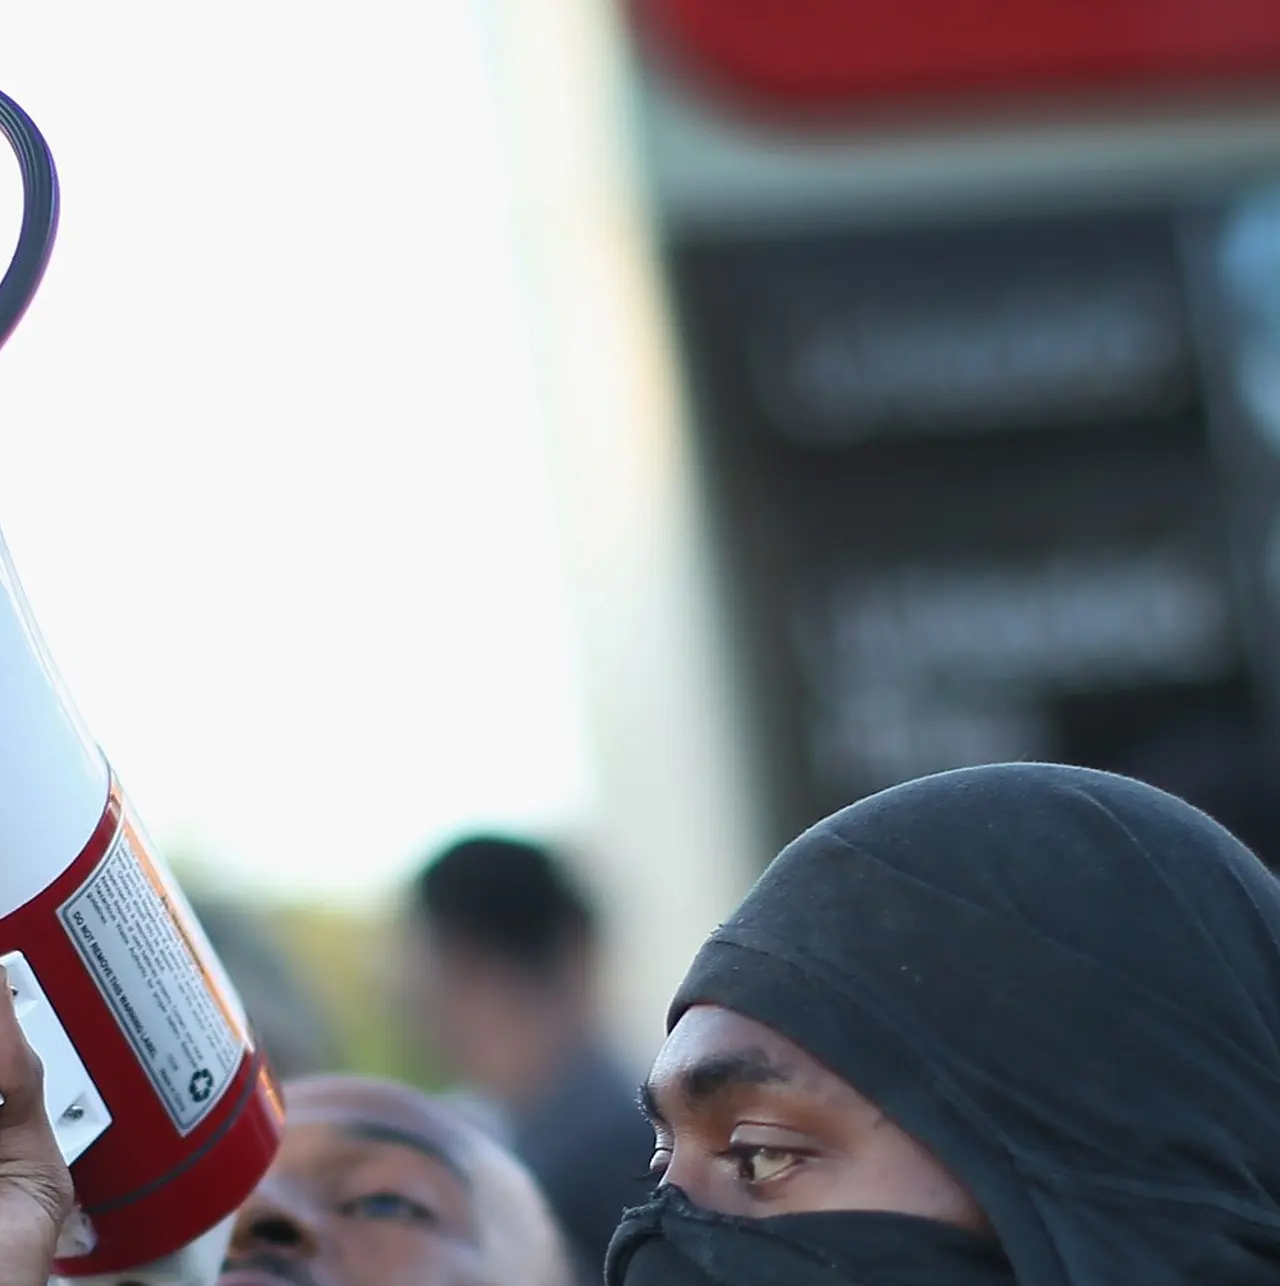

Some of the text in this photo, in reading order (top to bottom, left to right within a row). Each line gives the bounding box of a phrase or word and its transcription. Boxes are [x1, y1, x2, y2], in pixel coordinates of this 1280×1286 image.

[71, 909, 159, 1059] DO NOT REMOVE THIS WARNING LABEL
